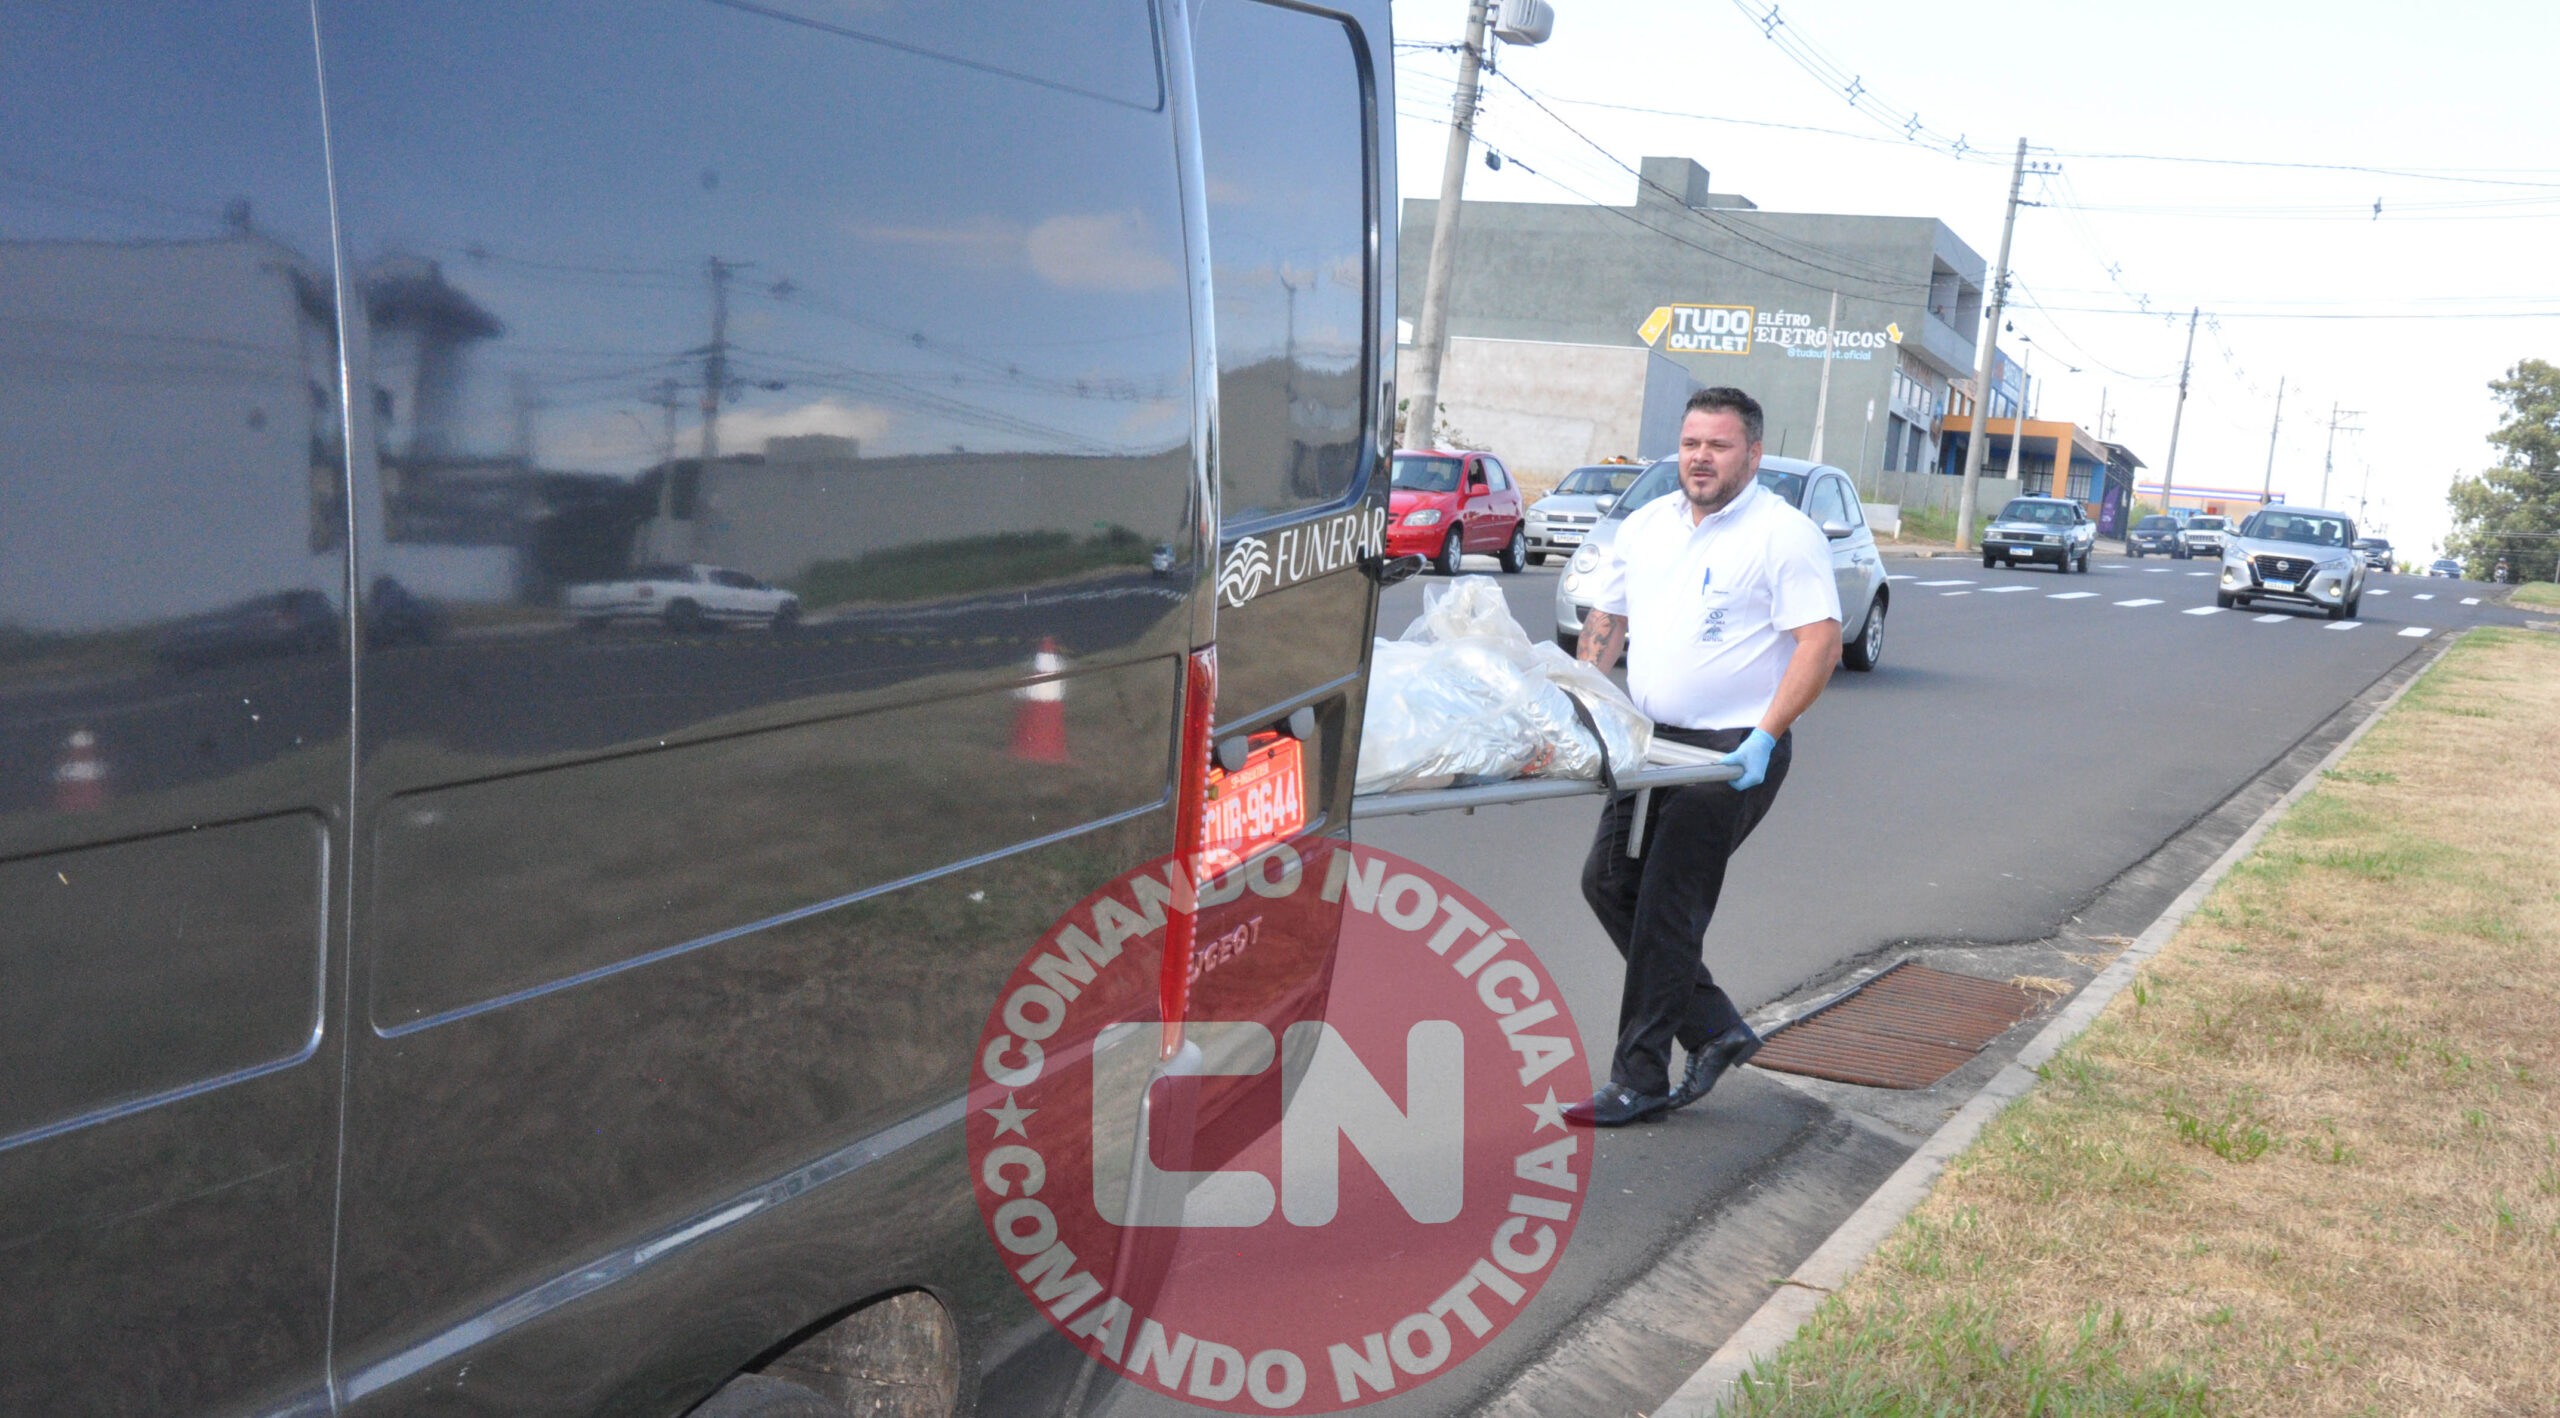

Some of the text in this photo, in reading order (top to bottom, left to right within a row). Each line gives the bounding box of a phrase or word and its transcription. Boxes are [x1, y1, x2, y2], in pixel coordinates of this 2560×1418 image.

[1674, 307, 1750, 335] TUDO
[1758, 309, 1811, 327] ELÉTRO
[1670, 333, 1747, 352] OUTLET
[1274, 496, 1386, 587] FUNERÁR
